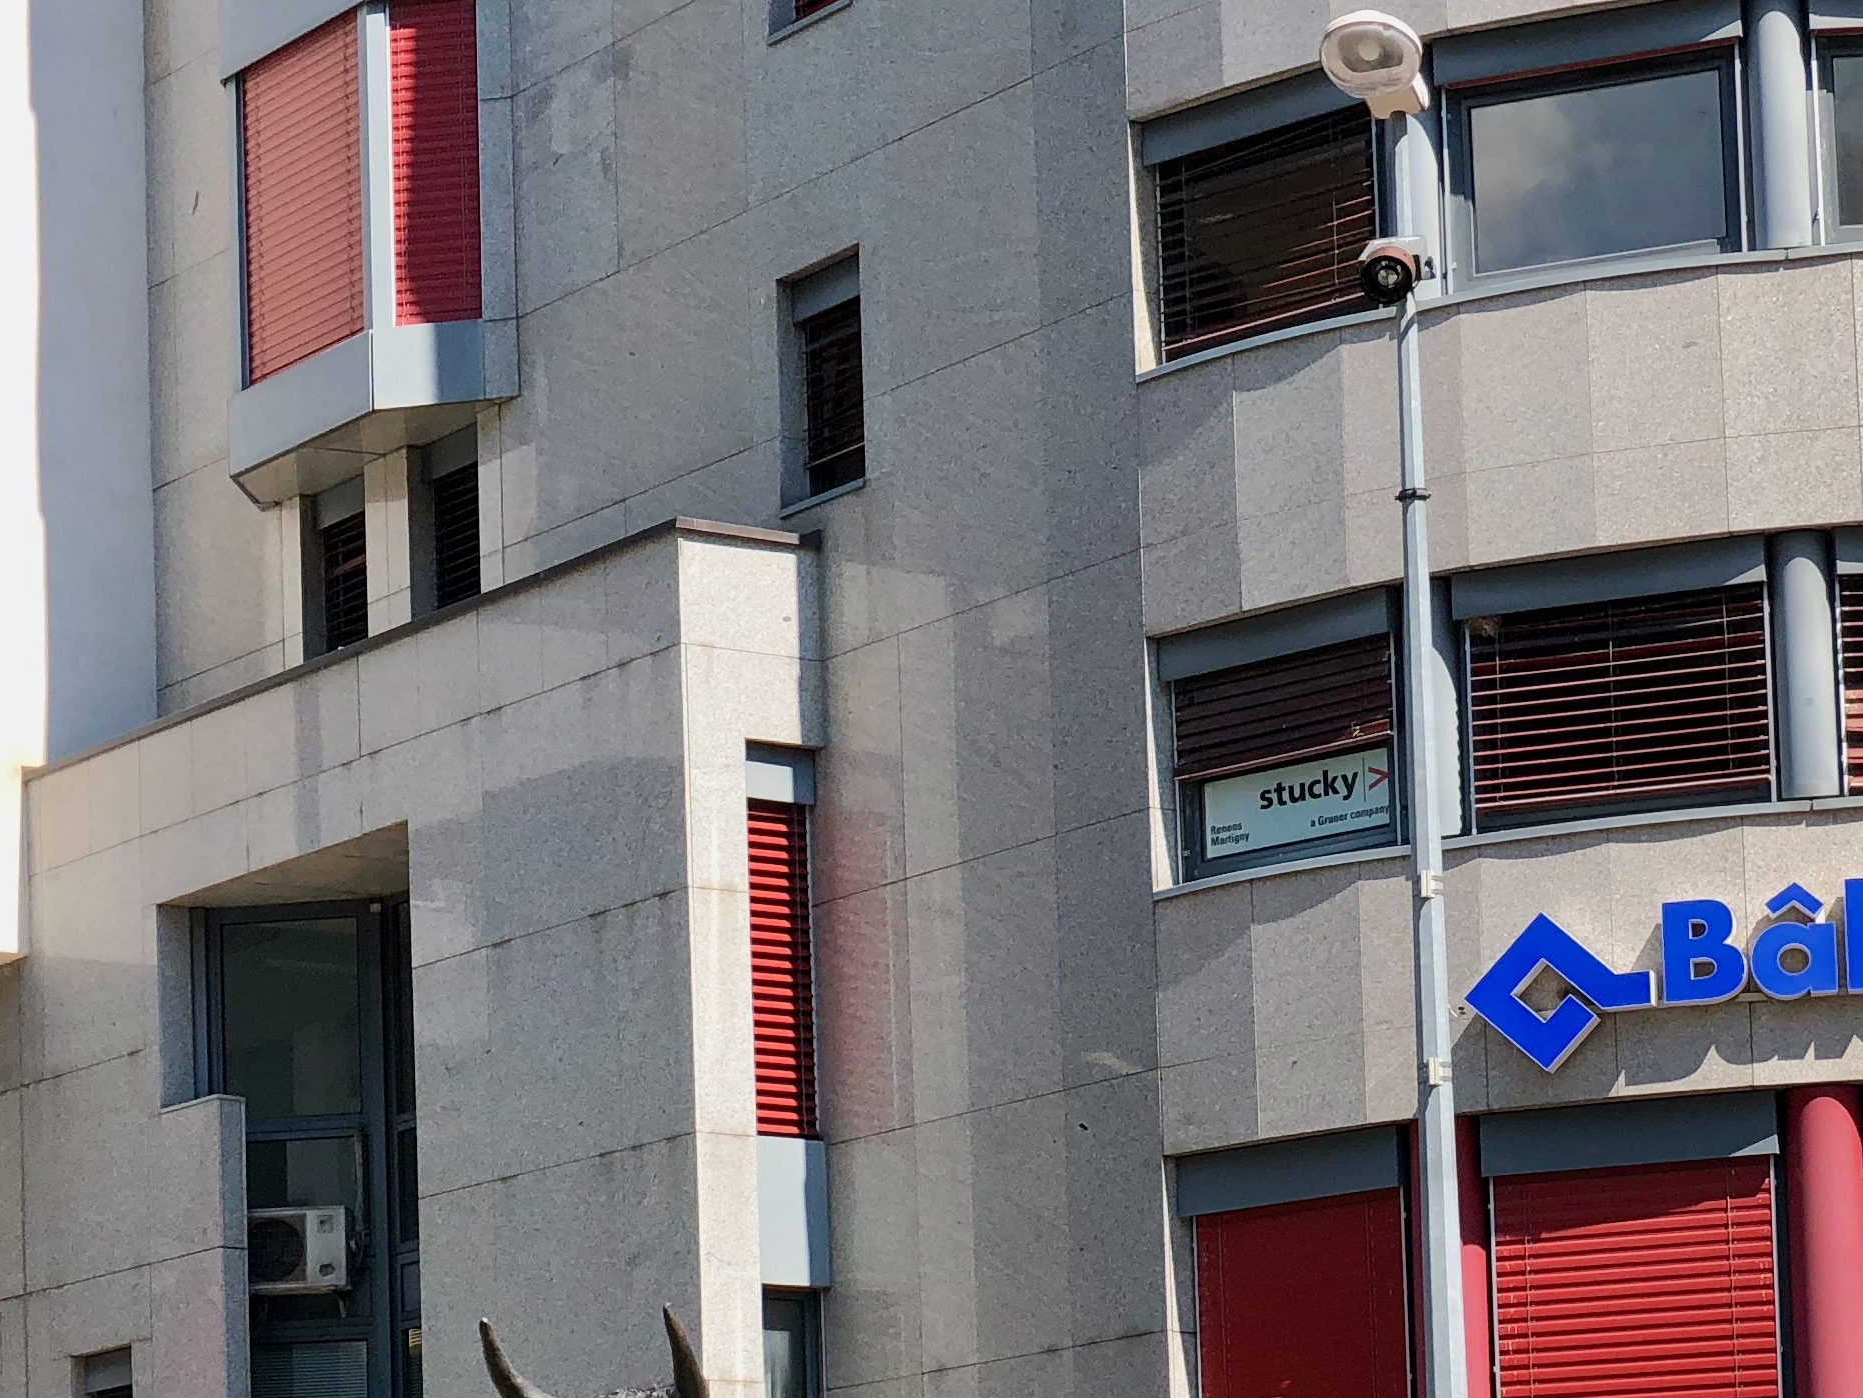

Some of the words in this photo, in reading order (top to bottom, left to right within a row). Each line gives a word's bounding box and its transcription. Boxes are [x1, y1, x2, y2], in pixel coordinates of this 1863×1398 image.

[1259, 769, 1359, 810] stucky
[1350, 804, 1389, 821] company
[1210, 832, 1250, 848] Martigny
